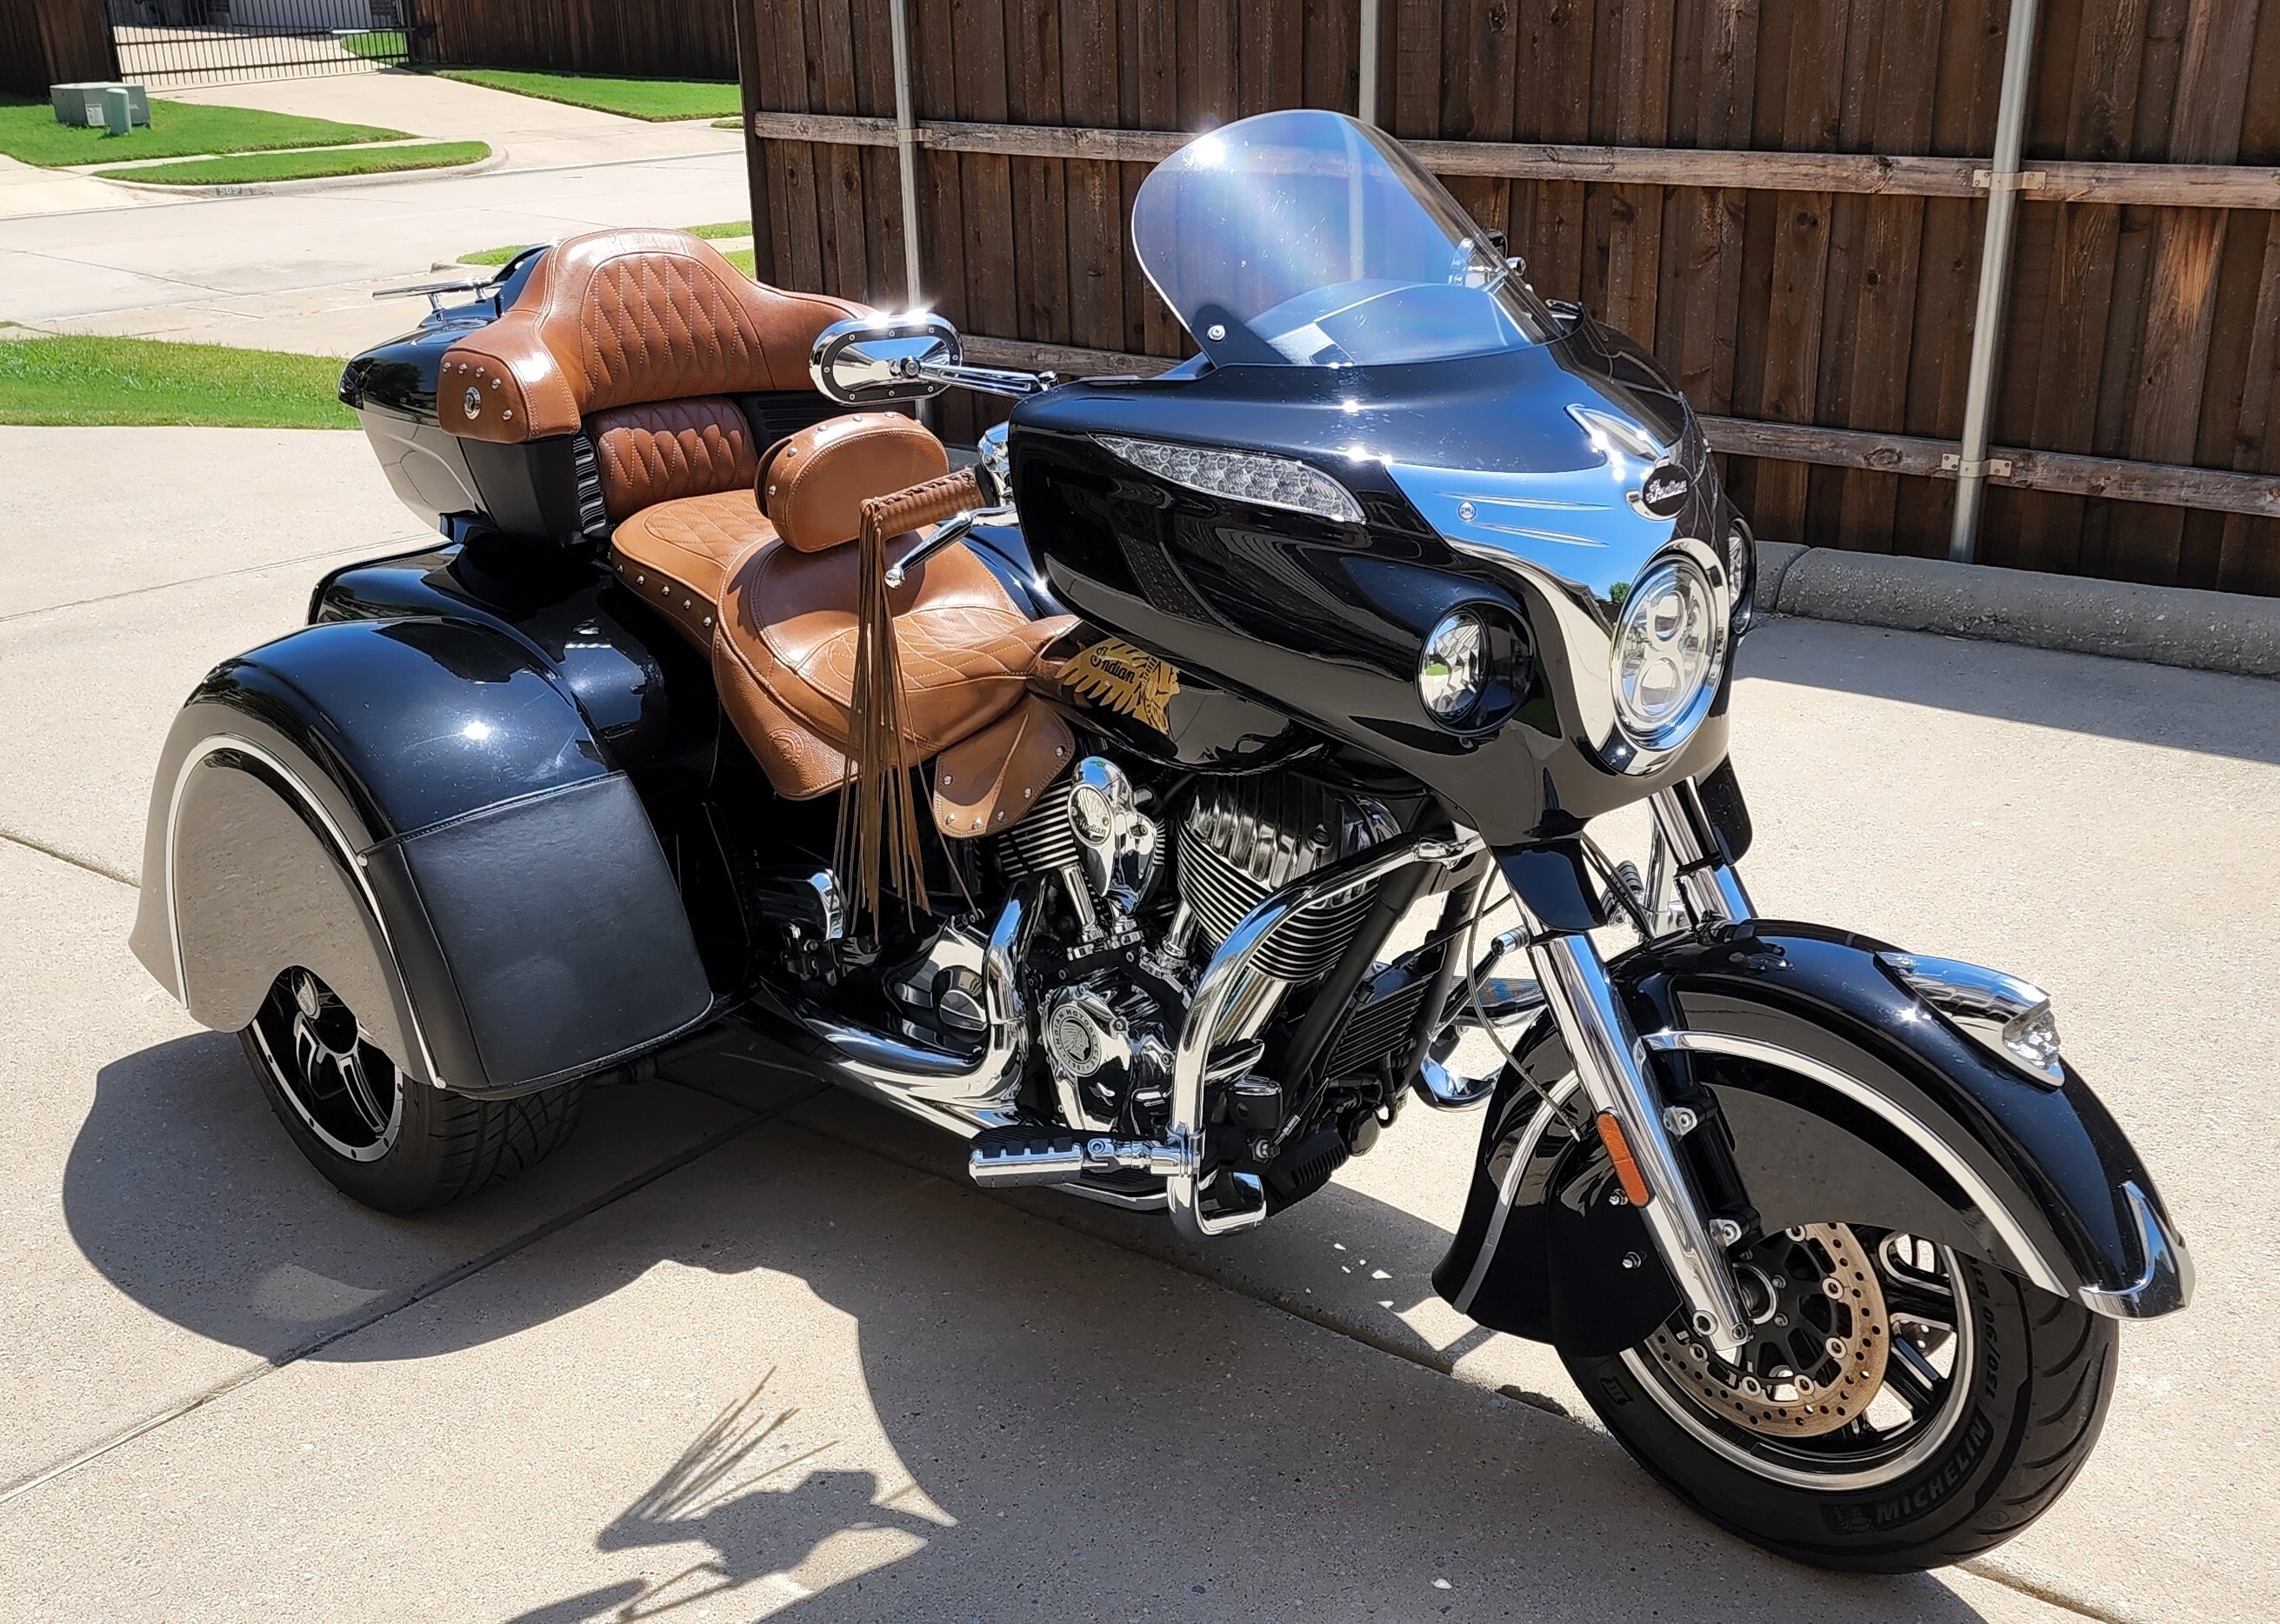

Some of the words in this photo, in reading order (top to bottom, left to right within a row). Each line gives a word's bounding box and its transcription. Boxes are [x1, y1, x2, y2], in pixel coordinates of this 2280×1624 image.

[1090, 646, 1134, 684] Indian
[1076, 817, 1107, 836] Indian
[1053, 1012, 1064, 1050] INDIAN
[1065, 1008, 1099, 1066] MOTORCYCLE
[1877, 1418, 1987, 1523] MICHELIN
